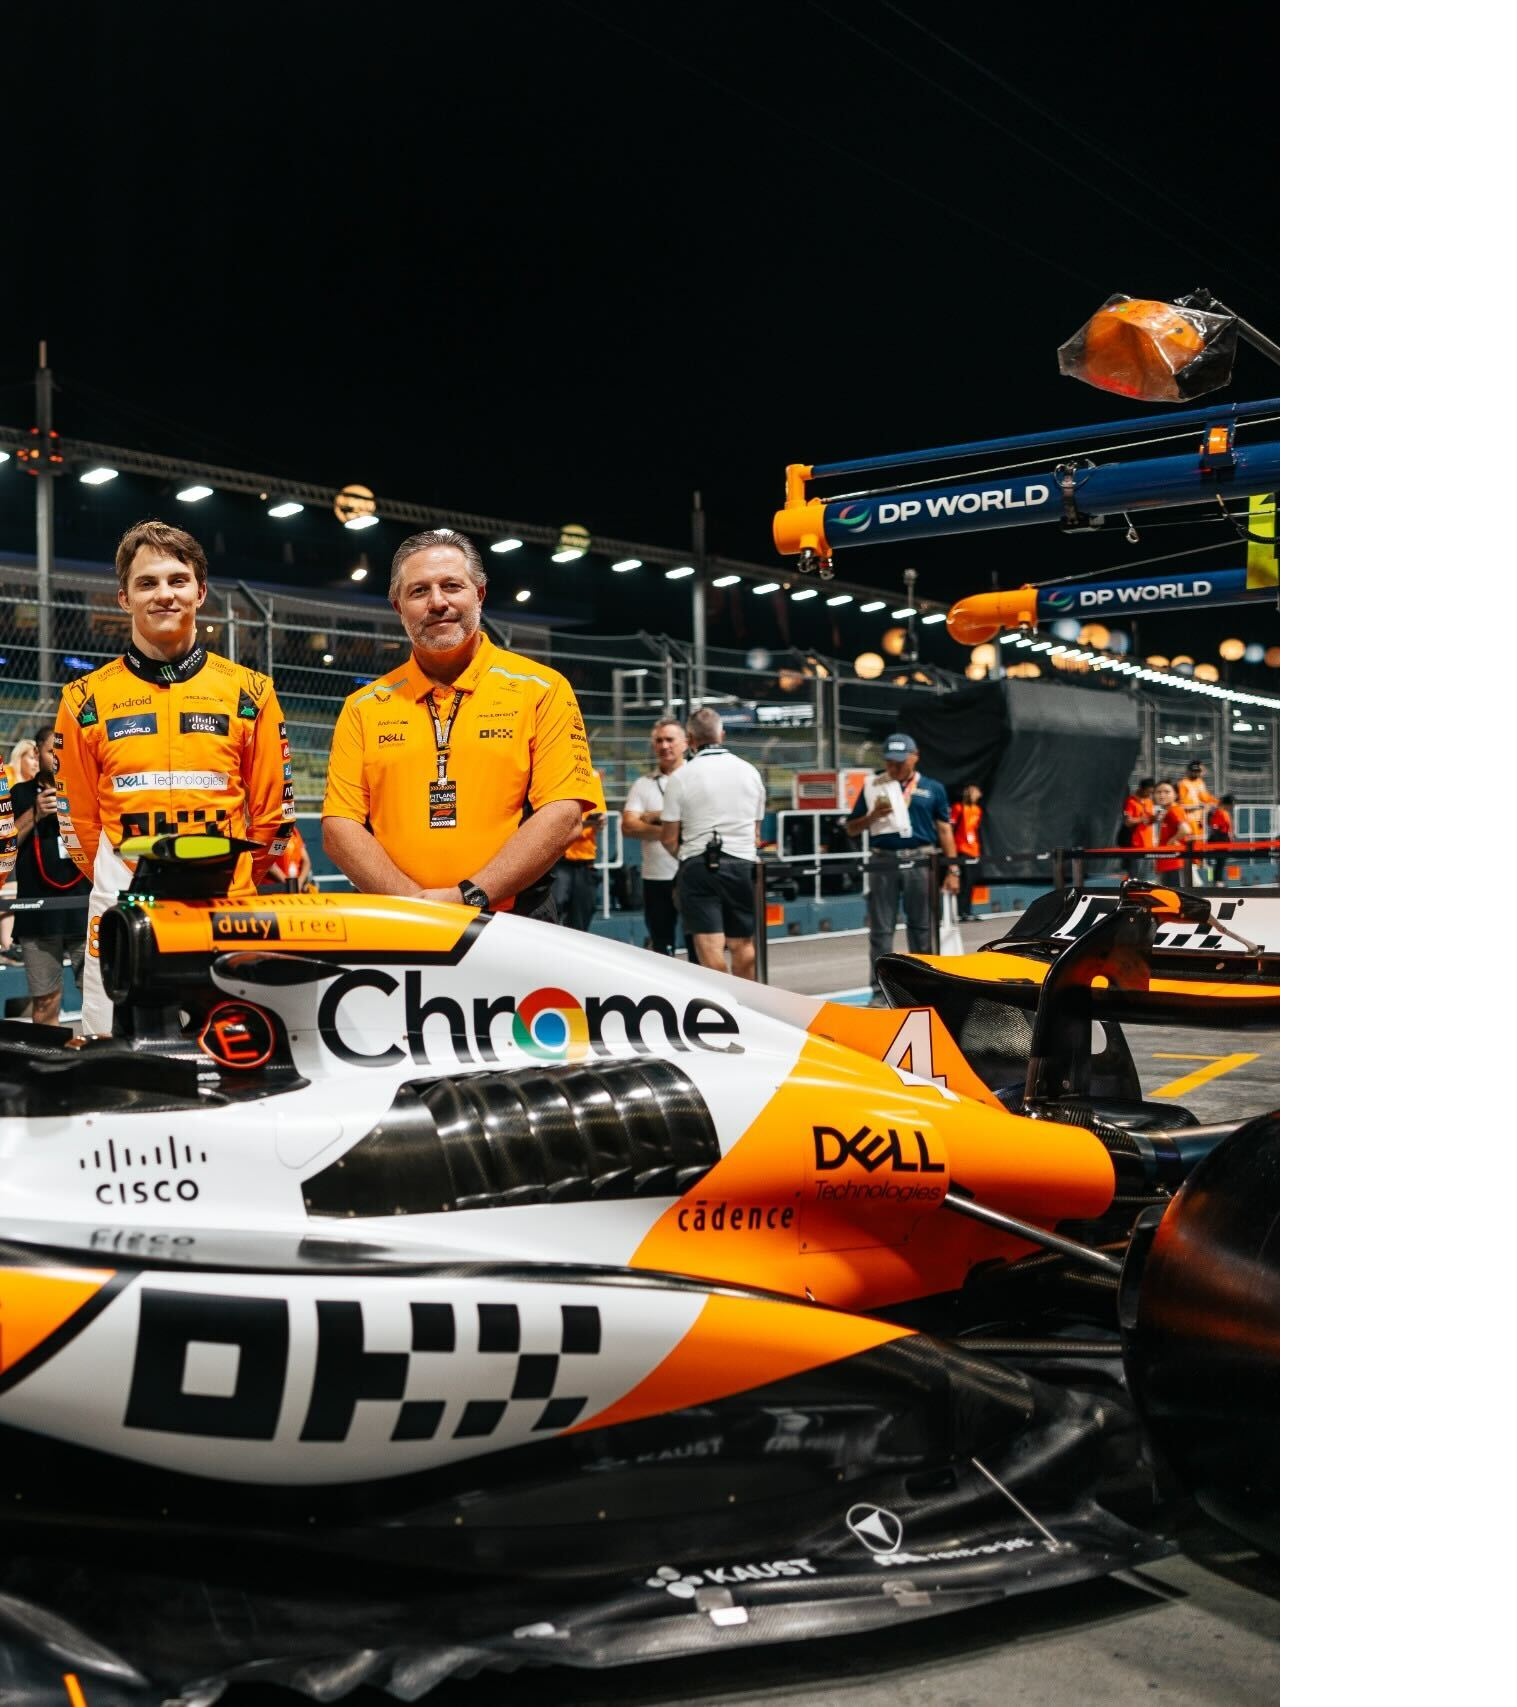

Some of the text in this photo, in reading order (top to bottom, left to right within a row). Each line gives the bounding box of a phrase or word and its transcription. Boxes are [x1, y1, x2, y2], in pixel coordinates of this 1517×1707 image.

[879, 485, 1049, 524] DP WORLD
[1080, 580, 1212, 606] DP WORLD
[112, 695, 152, 712] Android
[114, 726, 151, 738] DP WORLD
[192, 723, 215, 732] CISCO
[379, 732, 406, 744] DELL
[479, 729, 513, 739] OKX
[116, 772, 225, 788] DELL Technologies
[218, 914, 337, 937] duty free
[318, 967, 746, 1069] Chrome
[213, 1015, 258, 1060] E
[882, 1008, 960, 1101] 4
[813, 1125, 946, 1173] DELL
[96, 1179, 199, 1204] CISCO
[814, 1179, 943, 1203] Technologies
[677, 1200, 794, 1232] cādence
[123, 1287, 601, 1443] OKX
[704, 1558, 818, 1584] KAUST
